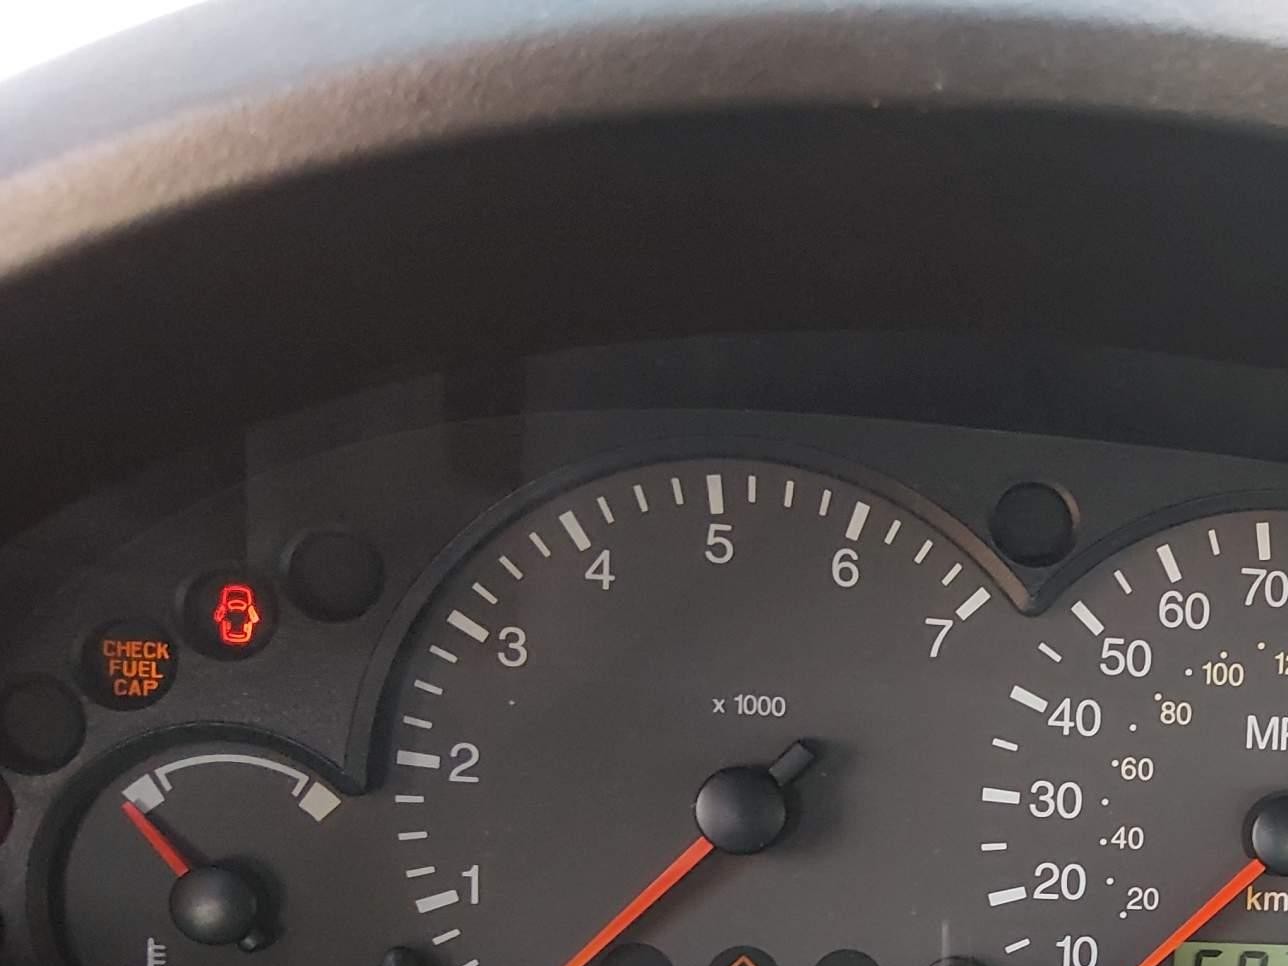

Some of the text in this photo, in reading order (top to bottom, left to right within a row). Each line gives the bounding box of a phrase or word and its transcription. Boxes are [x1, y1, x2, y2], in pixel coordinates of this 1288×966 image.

[704, 523, 734, 564] 5
[584, 549, 616, 590] 4
[831, 548, 860, 588] 6
[1158, 590, 1210, 630] 60
[103, 640, 169, 659] CHECK
[497, 626, 528, 667] 3
[924, 617, 954, 658] 7
[109, 659, 163, 678] FUEL
[1099, 637, 1152, 678] 50
[1201, 661, 1245, 687] 100
[114, 679, 159, 696] CAP
[733, 693, 786, 717] 1000
[1047, 697, 1102, 737] 40
[1159, 701, 1192, 726] 80
[448, 742, 480, 783] 2
[1120, 756, 1154, 781] 60
[1028, 780, 1083, 819] 30
[1110, 826, 1144, 850] 40
[463, 864, 479, 905] 1
[1032, 862, 1087, 901] 20
[1126, 886, 1160, 911] 20
